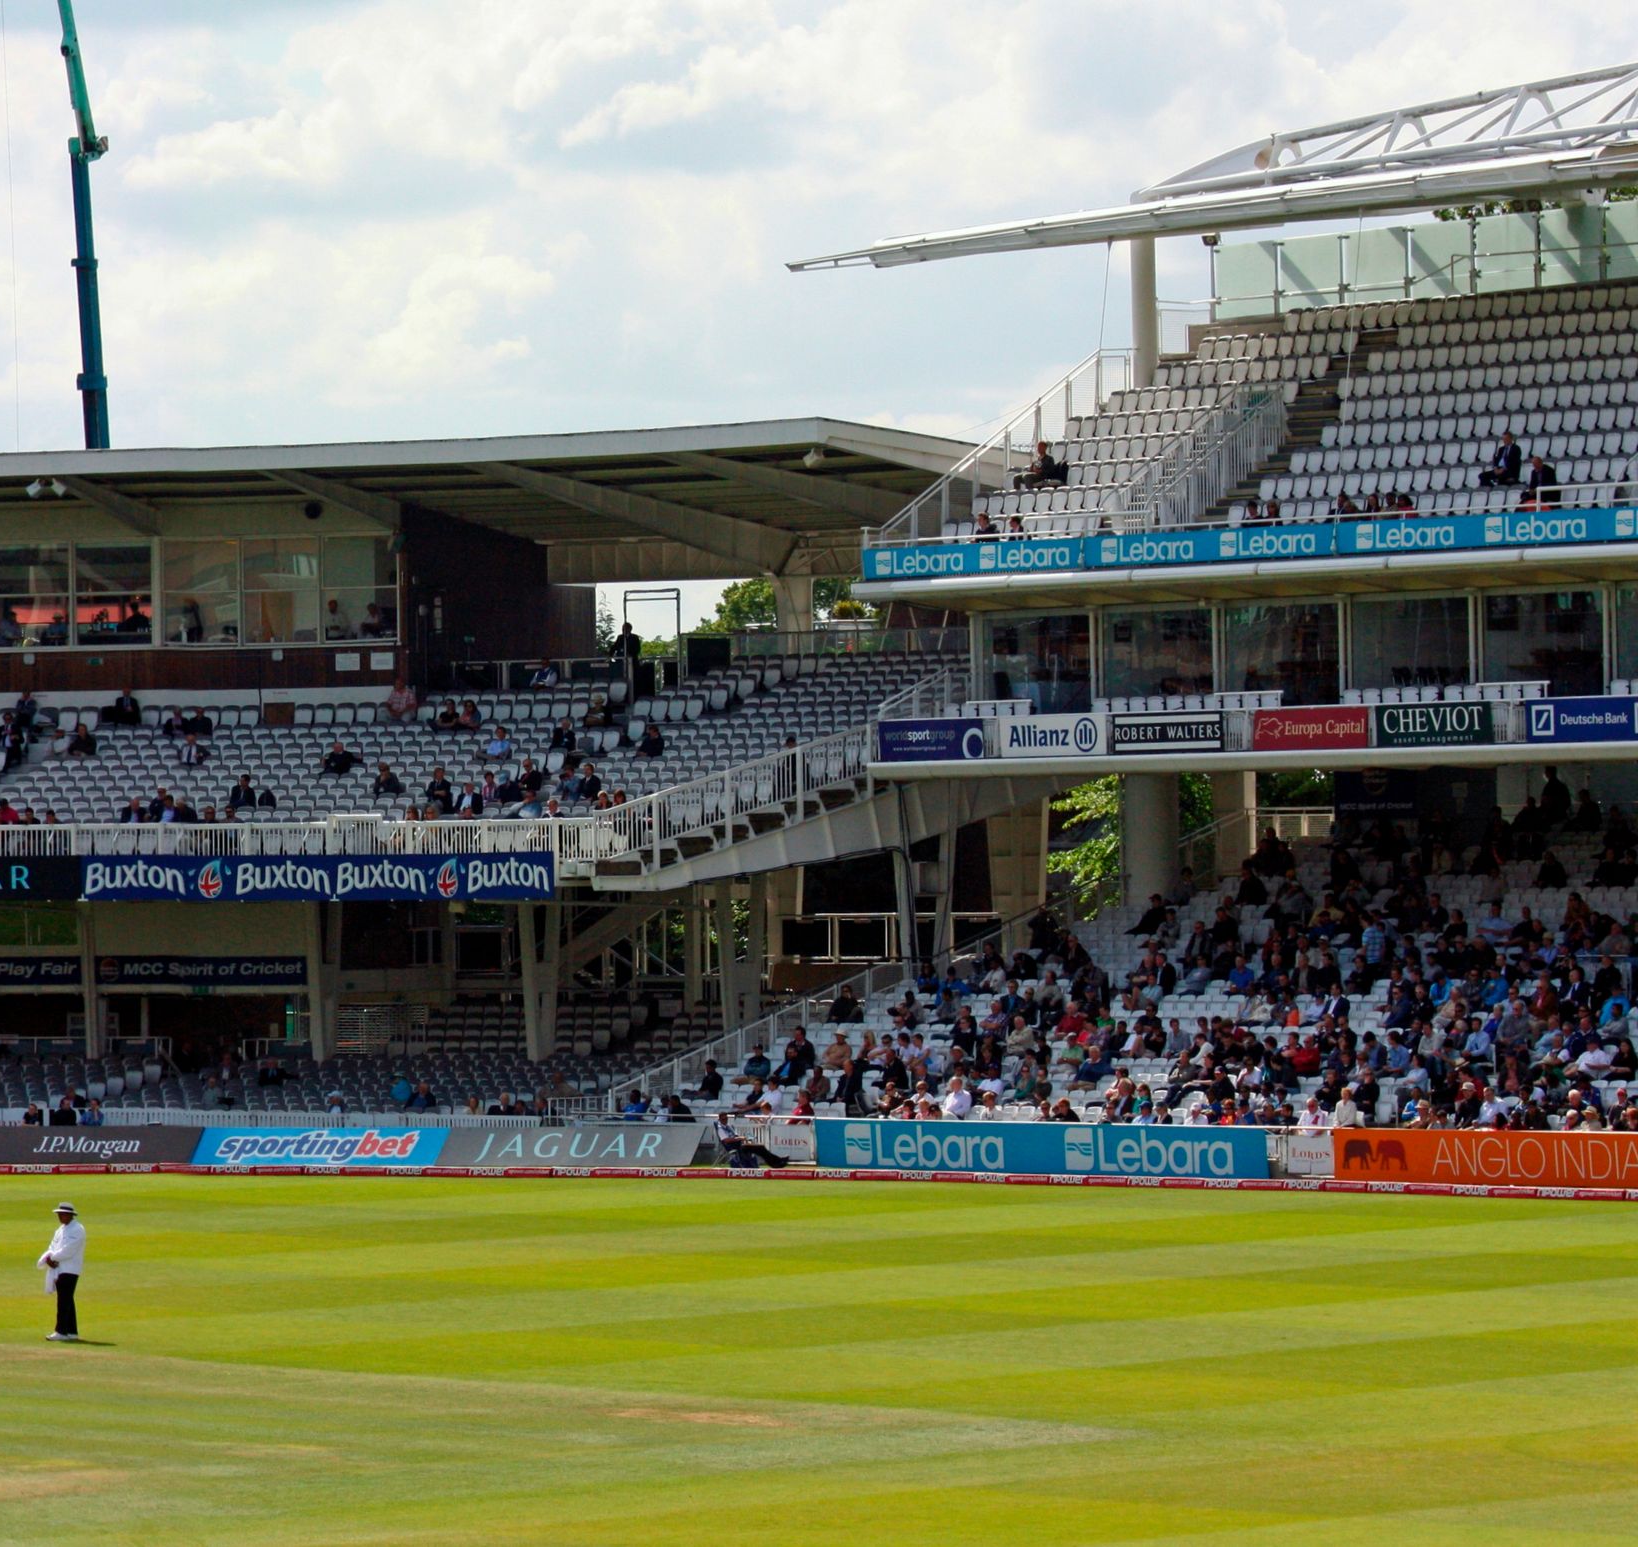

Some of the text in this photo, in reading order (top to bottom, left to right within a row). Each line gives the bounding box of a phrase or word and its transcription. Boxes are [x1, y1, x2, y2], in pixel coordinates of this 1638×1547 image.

[1375, 522, 1454, 548] Lebara
[1505, 515, 1586, 541] Lebara
[1120, 537, 1193, 562] Lebara
[1239, 529, 1315, 555] Lebara
[893, 550, 963, 574] Lebara
[998, 544, 1069, 573] Lebara
[1285, 718, 1364, 738] Europa Capital
[1383, 706, 1482, 733] CHEVIOT
[1560, 712, 1628, 725] Deutsche Bank
[1009, 725, 1069, 747] Allianz
[1114, 725, 1221, 741] ROBERT WALTERS
[85, 860, 185, 895] Buxton
[236, 860, 331, 895] Buxton
[336, 860, 426, 895] Buxton
[468, 857, 549, 893] Buxton
[33, 1136, 140, 1158] J.P.Morgan
[216, 1130, 420, 1164] sportingbet
[475, 1133, 662, 1162] JAGUAR
[870, 1124, 1004, 1169] Lebara
[1097, 1129, 1233, 1175] Lebara
[1433, 1137, 1545, 1178] ANGLO
